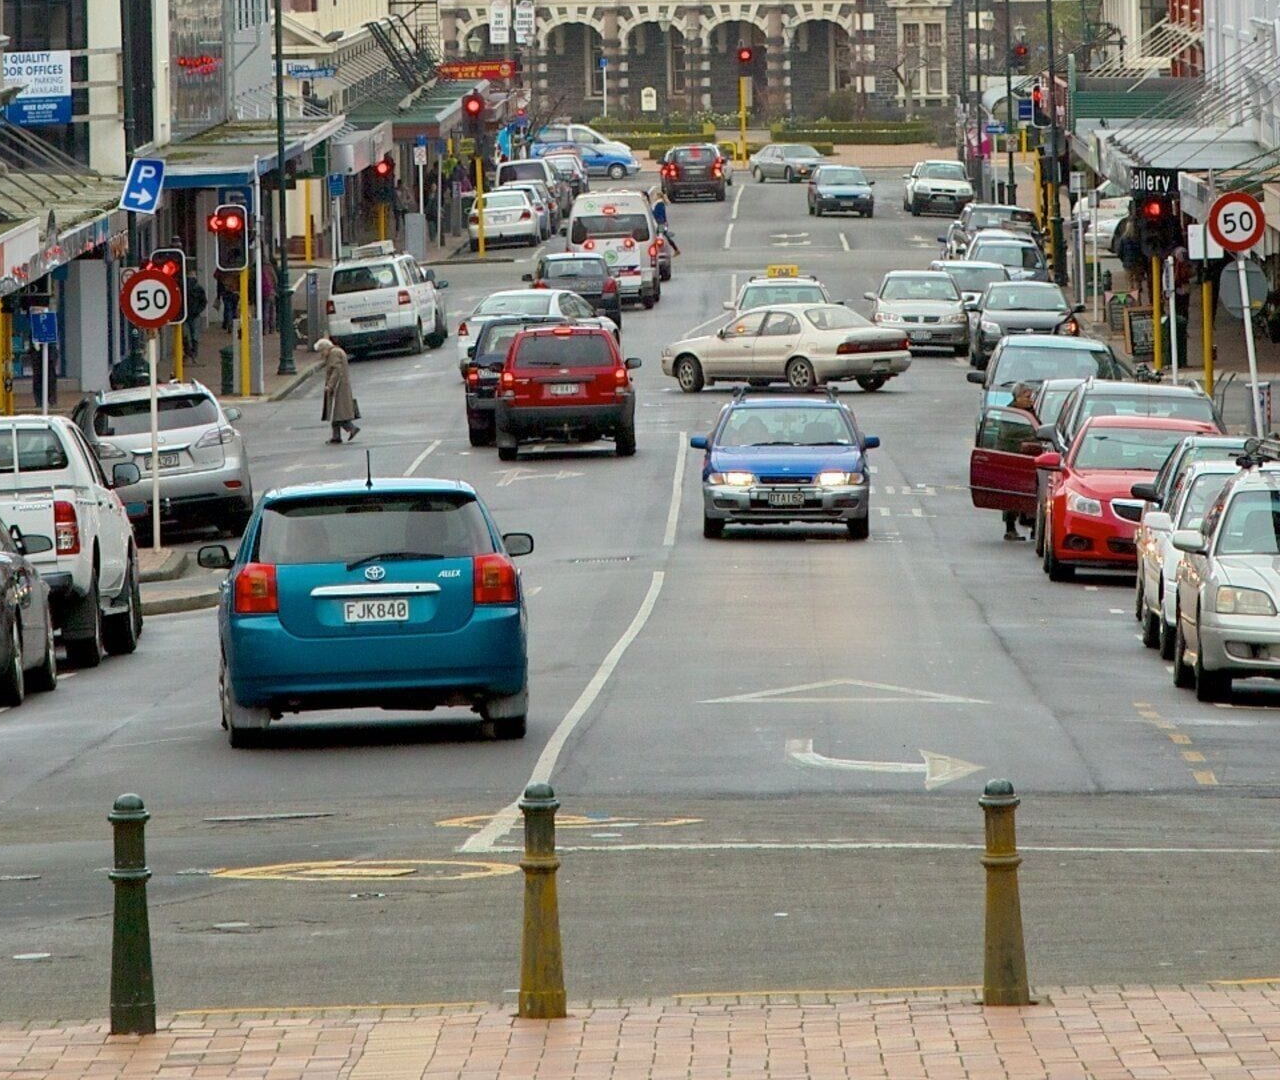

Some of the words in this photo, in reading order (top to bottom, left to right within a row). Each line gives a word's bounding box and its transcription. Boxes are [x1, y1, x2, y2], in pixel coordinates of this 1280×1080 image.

[10, 52, 51, 65] QUALITY
[25, 64, 64, 76] OFFICES
[138, 166, 156, 183] P
[1223, 211, 1254, 234] 50
[136, 289, 168, 311] 50
[438, 569, 461, 578] ALLEX
[346, 601, 407, 621] FJK840
